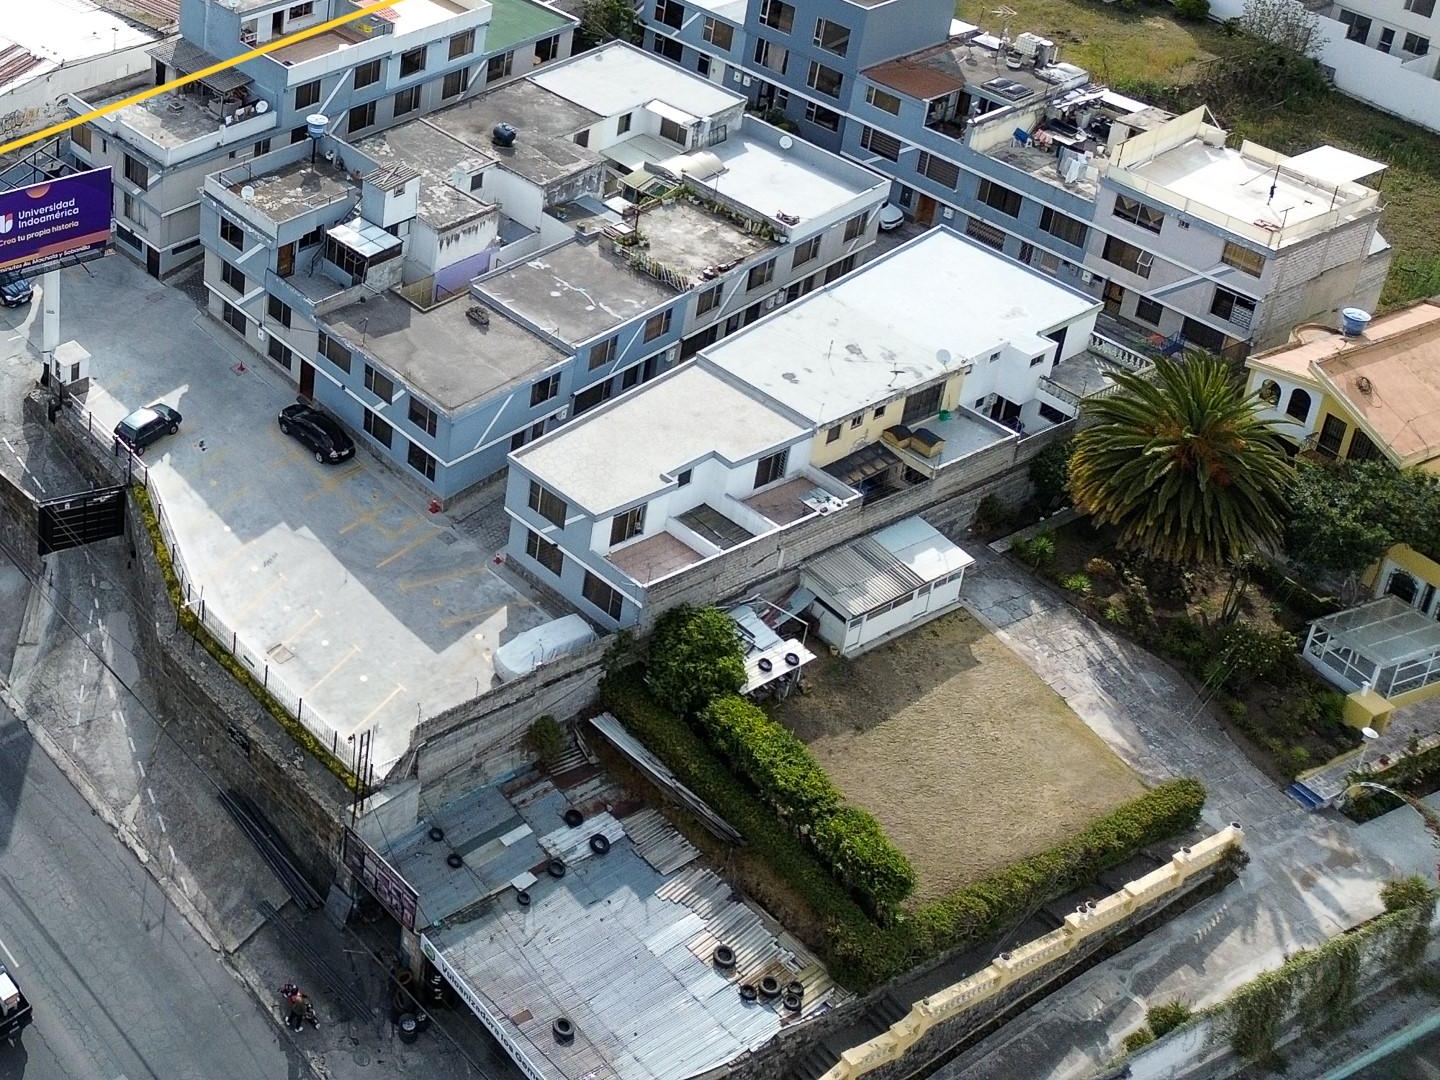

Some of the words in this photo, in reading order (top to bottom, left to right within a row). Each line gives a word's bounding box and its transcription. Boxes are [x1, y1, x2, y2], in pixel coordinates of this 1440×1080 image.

[18, 197, 76, 220] Universidad
[18, 207, 80, 229] Indoamérica
[17, 234, 26, 242] tu
[27, 228, 51, 240] propia
[52, 221, 79, 232] historia
[440, 962, 500, 1036] Vulcanizadora
[500, 1033, 514, 1053] los
